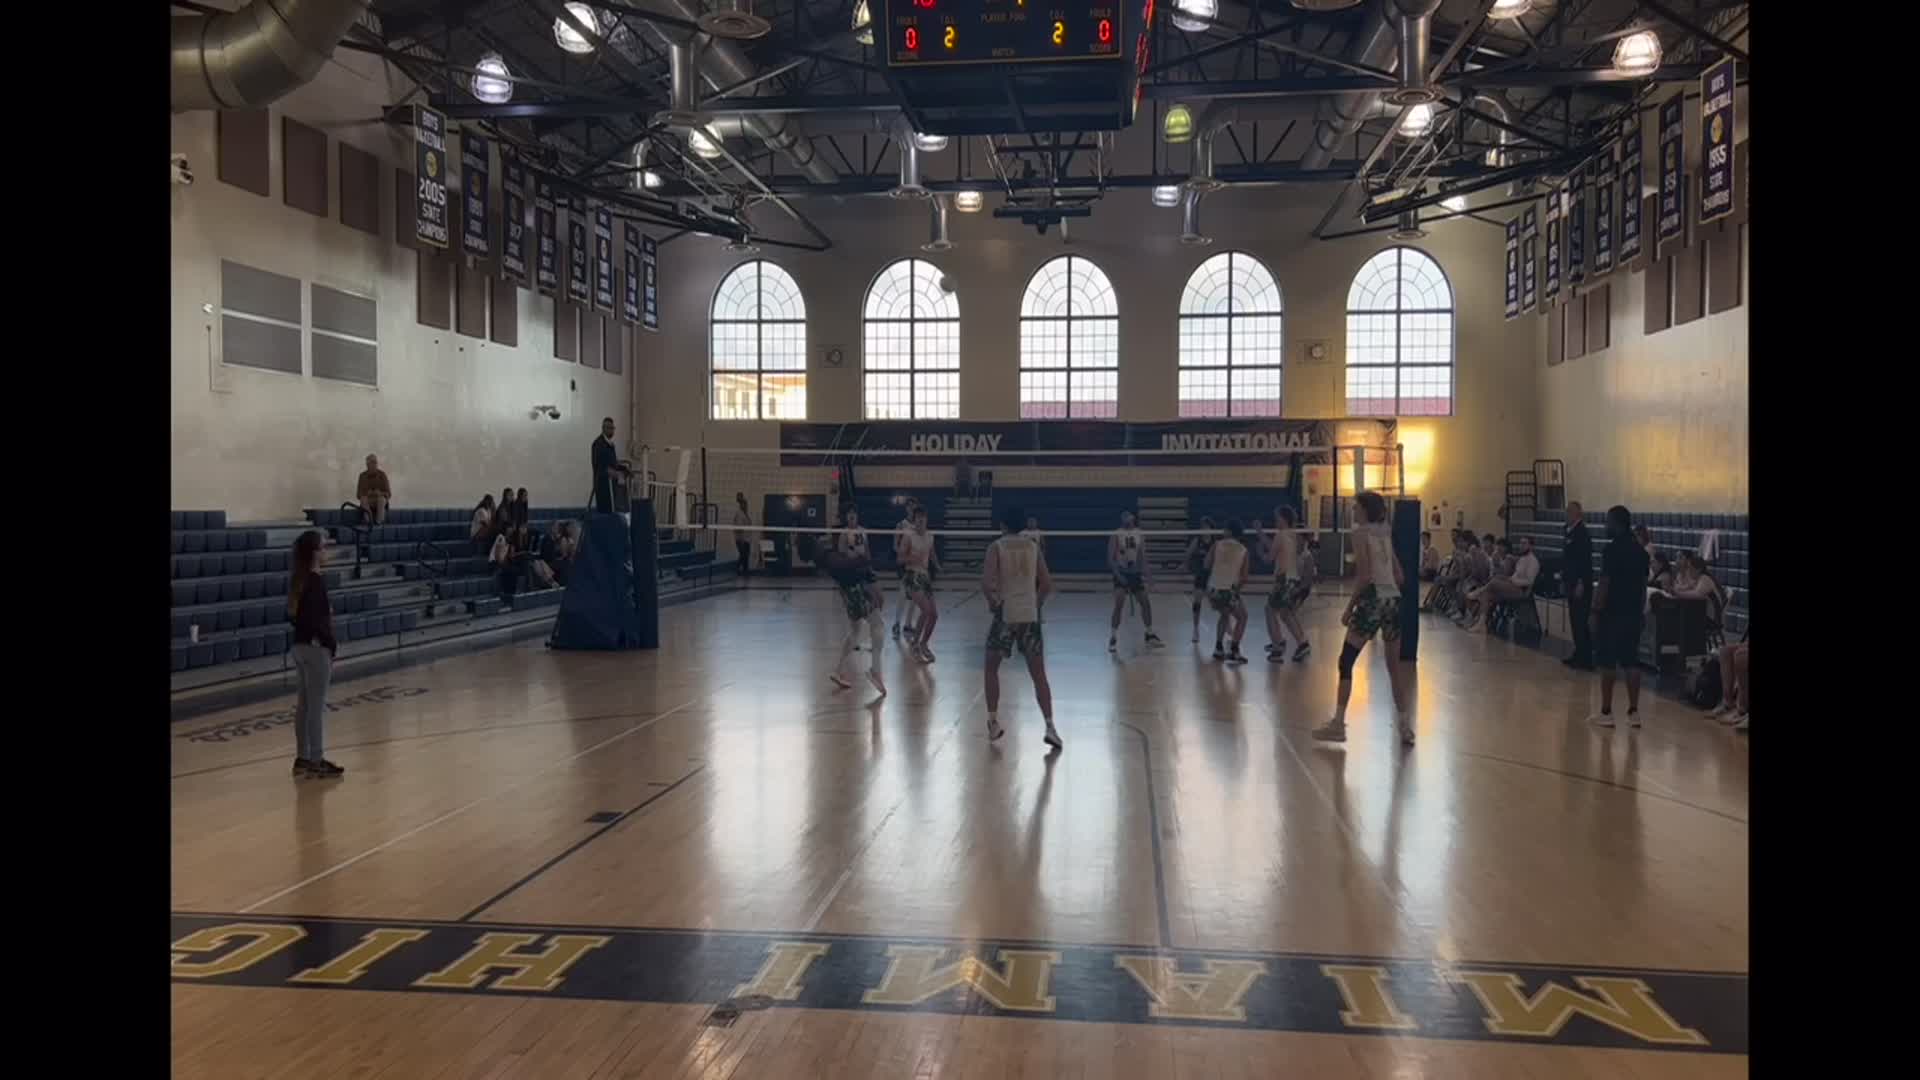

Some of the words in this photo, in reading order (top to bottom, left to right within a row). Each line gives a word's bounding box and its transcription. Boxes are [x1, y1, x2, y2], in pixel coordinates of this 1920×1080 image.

[906, 27, 918, 49] 0
[944, 26, 957, 48] 2
[1053, 21, 1065, 44] 2
[1099, 19, 1110, 42] 0
[418, 178, 446, 206] 2005
[422, 203, 441, 223] STATE
[911, 433, 1003, 454] HOLIDAY
[1161, 431, 1311, 452] INVITATIONAL
[728, 942, 1709, 1045] MIAMI
